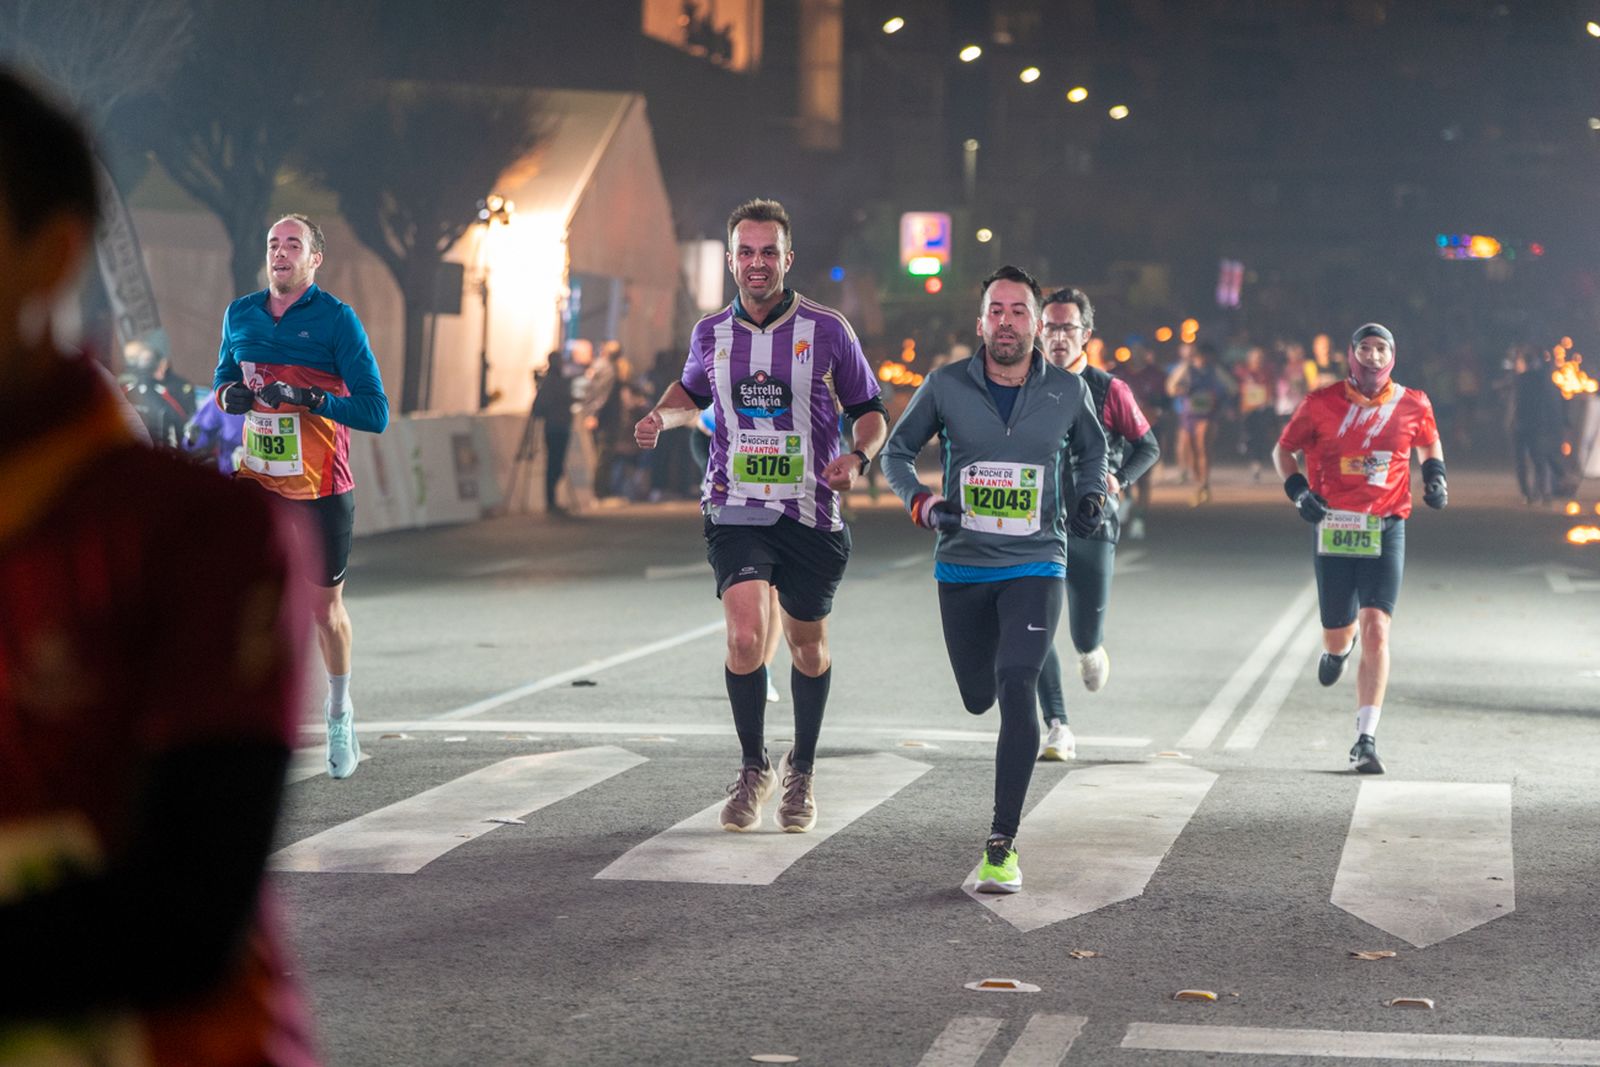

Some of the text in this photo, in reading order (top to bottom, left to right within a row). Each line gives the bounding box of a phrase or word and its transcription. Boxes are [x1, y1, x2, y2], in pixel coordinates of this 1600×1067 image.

[740, 384, 783, 395] Estrella
[742, 395, 782, 407] Galicia
[746, 454, 791, 477] 5176
[978, 469, 1014, 478] NOCHE DE
[969, 477, 986, 486] SAN
[970, 487, 1032, 511] 12043
[1332, 530, 1371, 548] 8475
